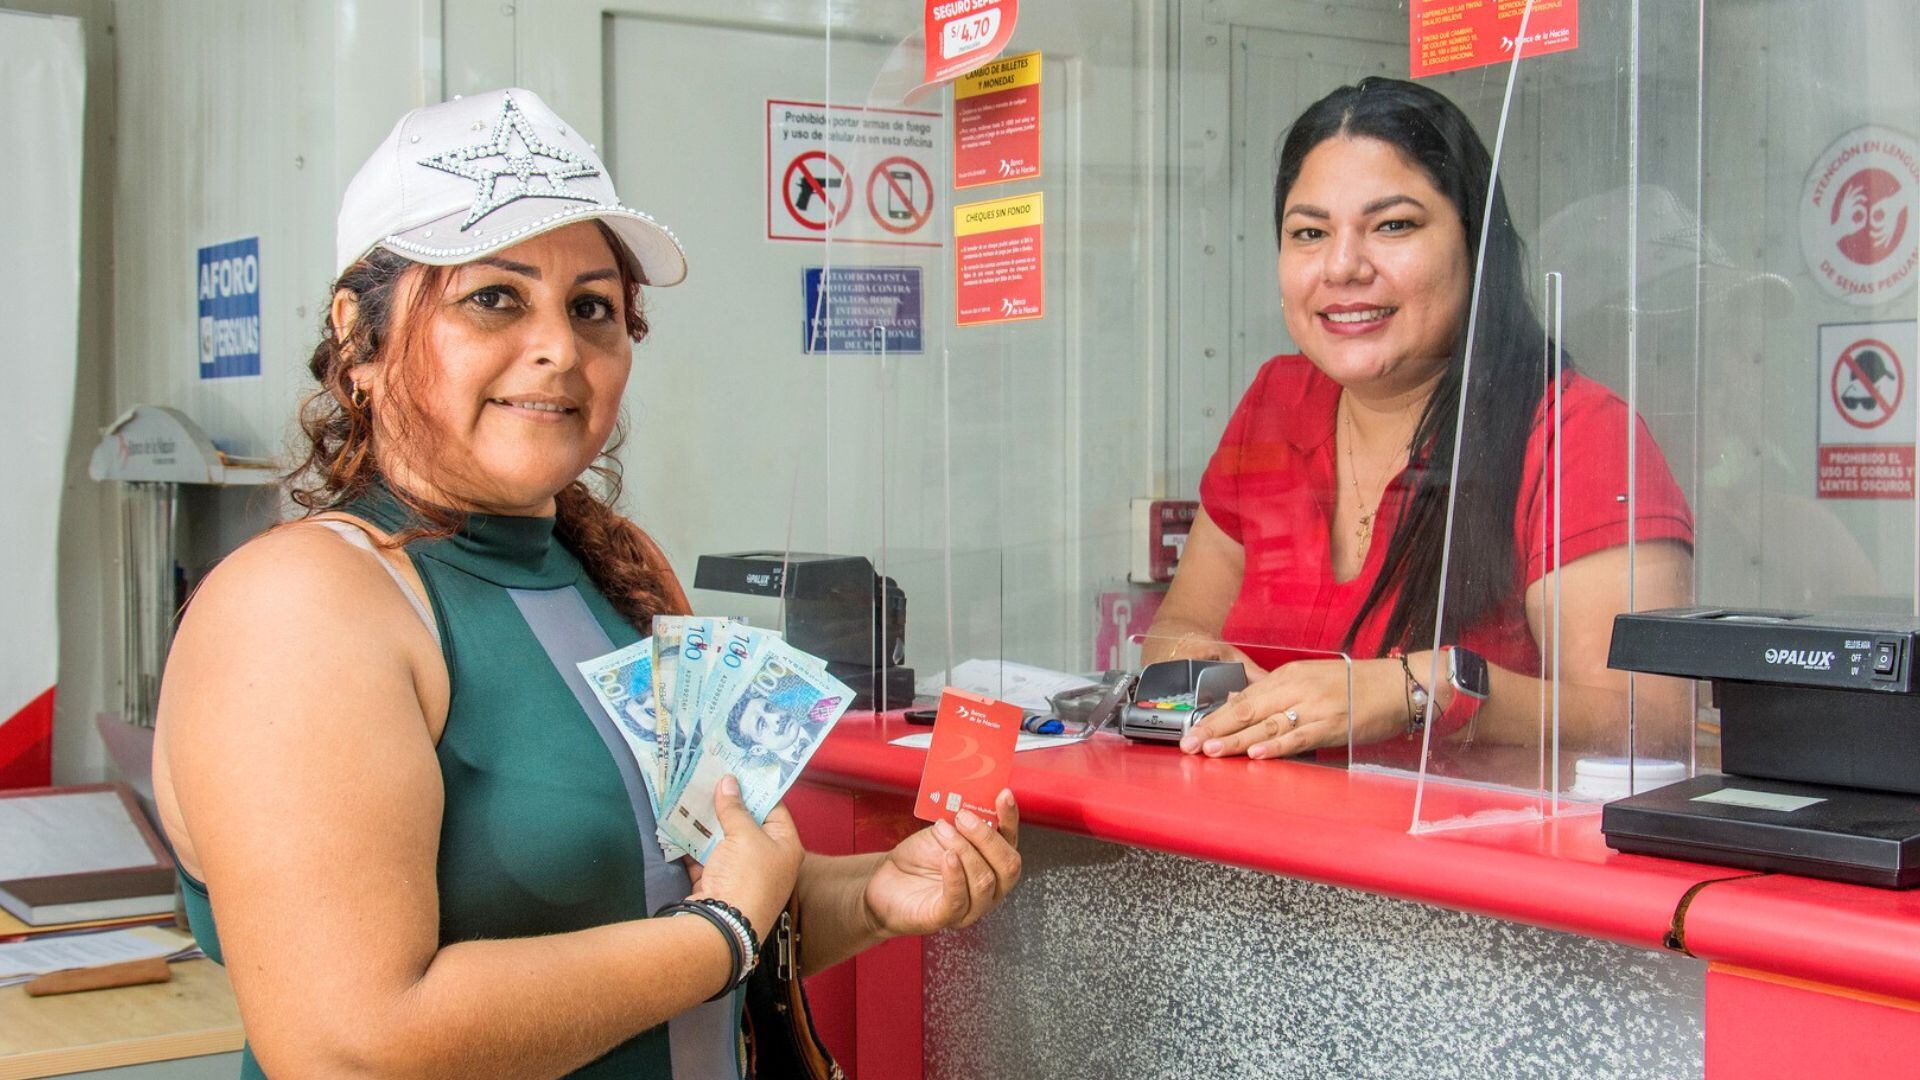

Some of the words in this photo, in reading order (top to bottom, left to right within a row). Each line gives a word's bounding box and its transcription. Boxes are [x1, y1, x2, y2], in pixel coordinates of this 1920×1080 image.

[933, 0, 971, 20] SEGURO
[961, 16, 990, 42] 4.70
[1515, 36, 1533, 46] Bnco
[965, 66, 991, 80] CAMBIO
[991, 64, 1001, 74] DE
[1001, 58, 1029, 73] BILLETES
[983, 74, 1015, 89] MONEDAS
[785, 111, 829, 126] Prohibid
[893, 120, 904, 131] de
[905, 121, 931, 136] fuego
[783, 130, 788, 140] y
[791, 129, 809, 139] uso
[811, 130, 823, 140] de
[868, 135, 881, 145] en
[882, 135, 901, 146] esta
[903, 135, 933, 149] oficina
[1864, 140, 1881, 154] EN
[966, 209, 995, 223] CHEQUES
[995, 207, 1006, 218] SIN
[1007, 204, 1031, 217] FONDO
[200, 254, 258, 300] AFORO
[817, 283, 871, 293] OTEGIDA
[1830, 453, 1886, 465] PROHIBIDO
[1820, 466, 1842, 478] USO
[1844, 466, 1858, 478] DE
[1820, 480, 1858, 491] LENTES
[1861, 480, 1911, 492] OSCUROS
[685, 626, 706, 661] 100
[722, 632, 751, 670] 100
[1765, 648, 1834, 666] OPALUX
[1851, 653, 1862, 663] OFF
[753, 659, 787, 698] 100
